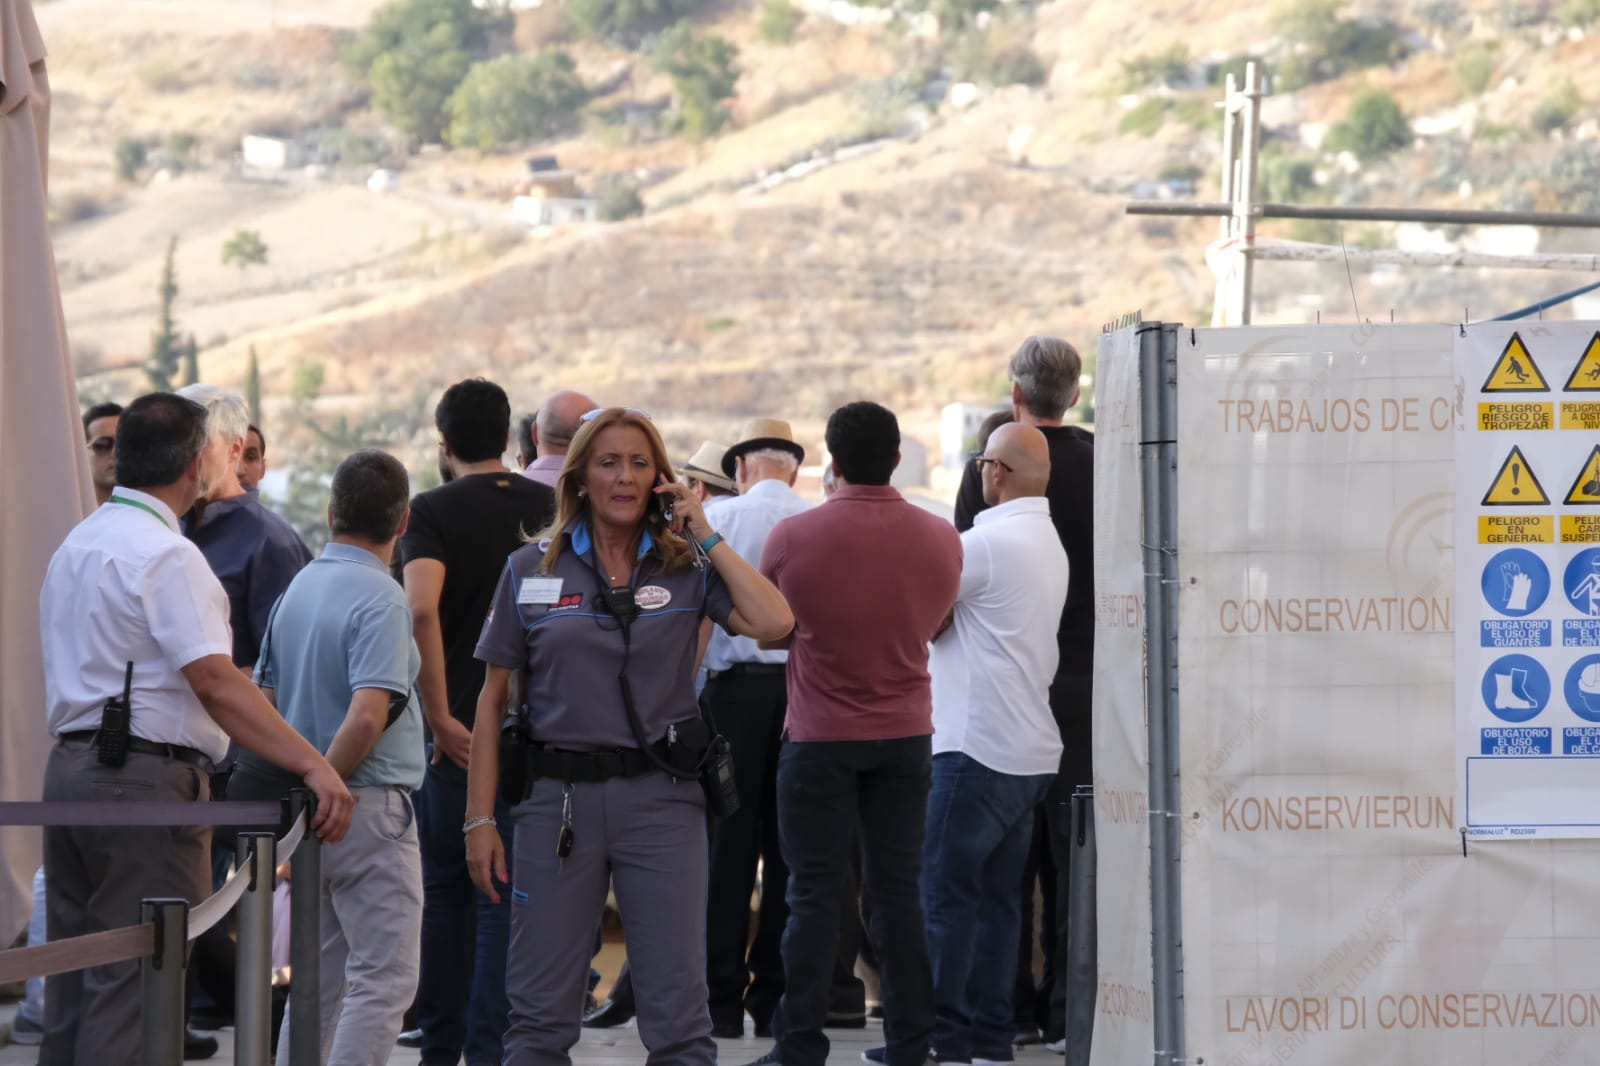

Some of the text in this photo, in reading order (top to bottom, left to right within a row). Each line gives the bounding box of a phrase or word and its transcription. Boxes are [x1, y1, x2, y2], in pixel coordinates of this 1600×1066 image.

[1489, 404, 1542, 413] PELIGRO
[1217, 396, 1456, 433] TRABAJOS DE C
[1482, 412, 1549, 421] RIESGO DE
[1571, 412, 1578, 421] A
[1483, 421, 1549, 430] TROPEZAR
[1488, 517, 1540, 526] PELIGRO
[1507, 525, 1524, 534] EN
[1487, 534, 1545, 543] GENERAL
[1562, 533, 1600, 542] SUSPE
[1219, 596, 1451, 634] CONSERVATION
[1483, 621, 1549, 630] OBLIGATORIO
[1491, 629, 1541, 638] EL USO DE
[1580, 629, 1592, 638] EL
[1494, 638, 1541, 647] GUANTES
[1565, 637, 1579, 646] DE
[1484, 729, 1549, 738] OBLIGATORIO
[1498, 737, 1533, 746] EL USO
[1581, 737, 1592, 745] EL
[1493, 746, 1541, 755] DE BOTAS
[1571, 745, 1589, 754] DEL
[1221, 795, 1455, 832] KONSERVIERUN
[1333, 932, 1402, 998] CULTURA
[1225, 996, 1329, 1032] LAVORI
[1339, 995, 1367, 1030] DI
